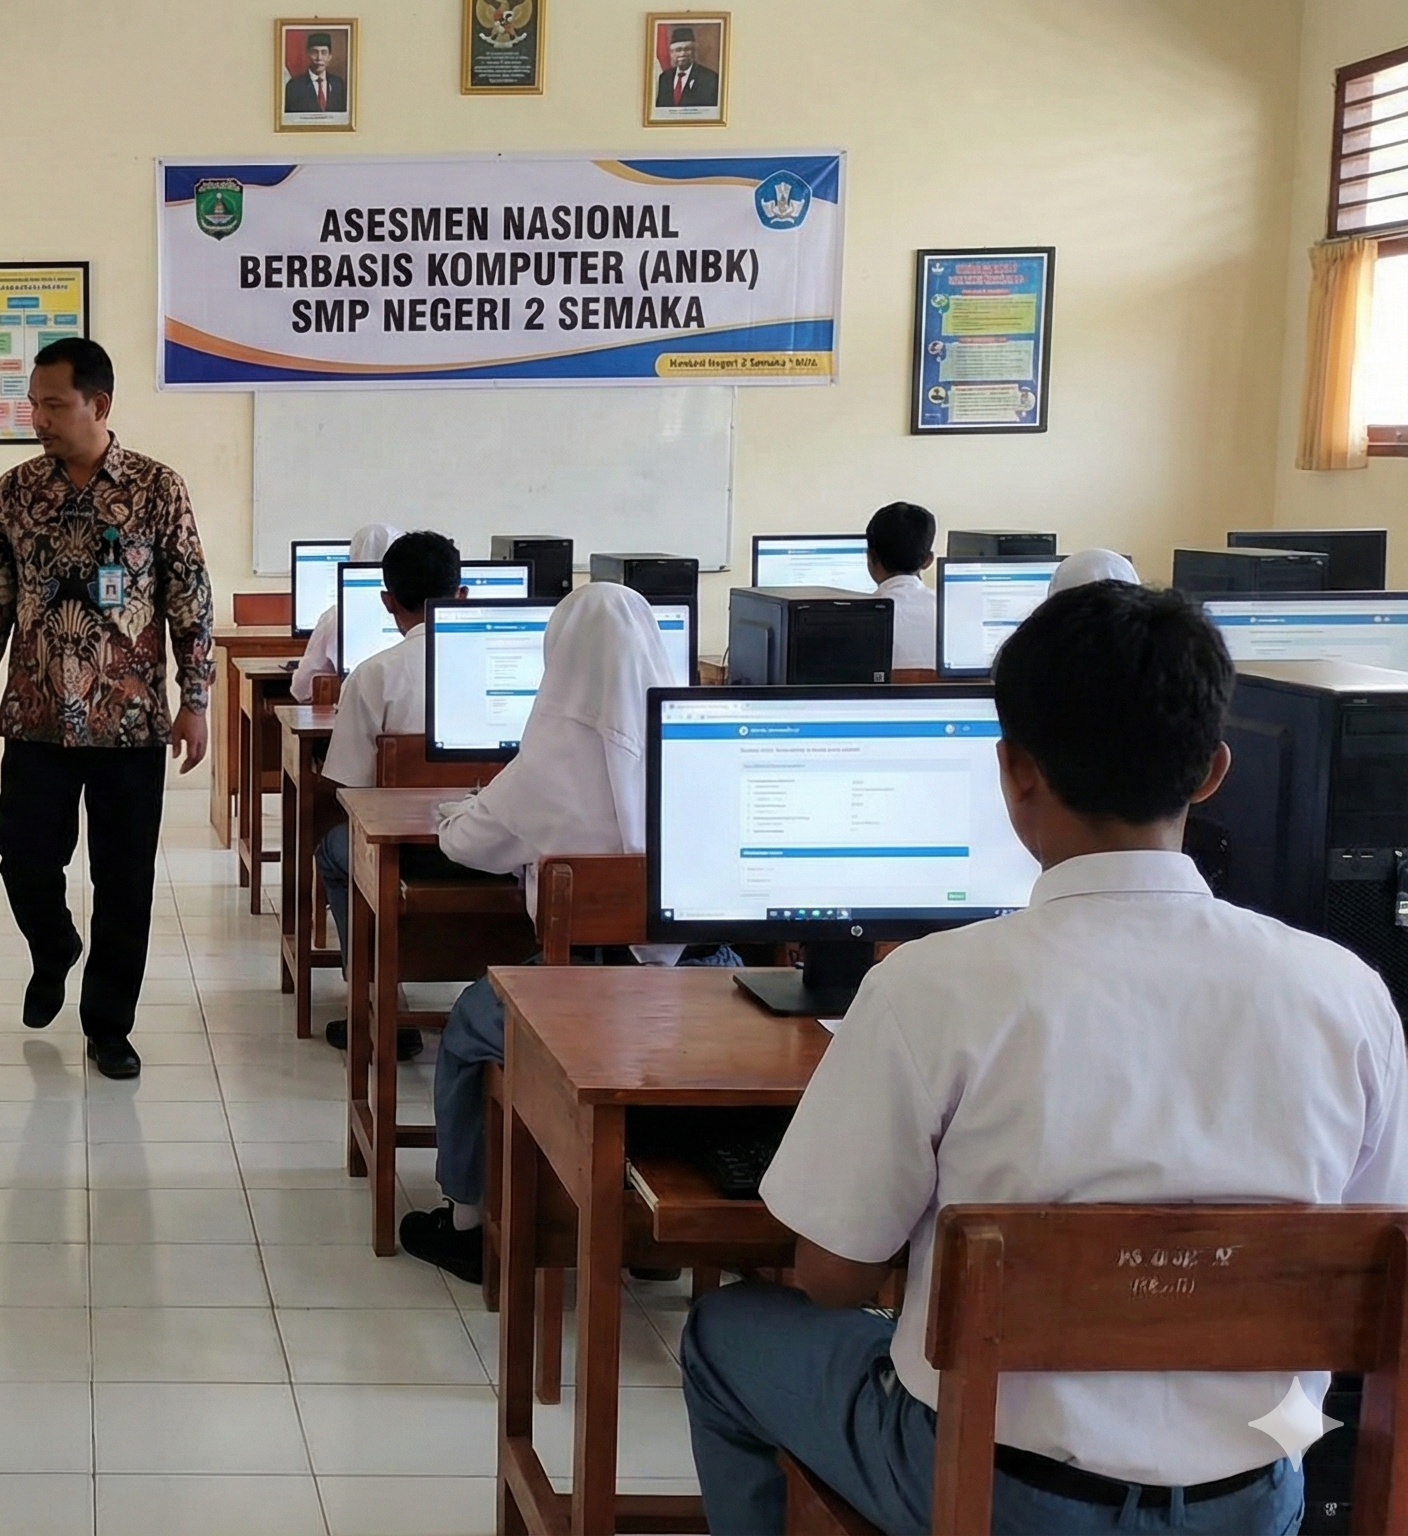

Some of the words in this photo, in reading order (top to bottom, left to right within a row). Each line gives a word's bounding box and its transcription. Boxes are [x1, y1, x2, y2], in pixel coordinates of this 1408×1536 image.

[319, 206, 489, 243] ASESMEN
[503, 204, 679, 241] NASIONAL
[240, 252, 413, 289] BERBASIS
[427, 249, 624, 288] KOMPUTER
[639, 248, 759, 291] (ANBK)
[291, 299, 370, 334] SMP
[383, 297, 511, 332] NEGERI
[523, 297, 545, 331] 2
[558, 295, 706, 331] SEMAKA
